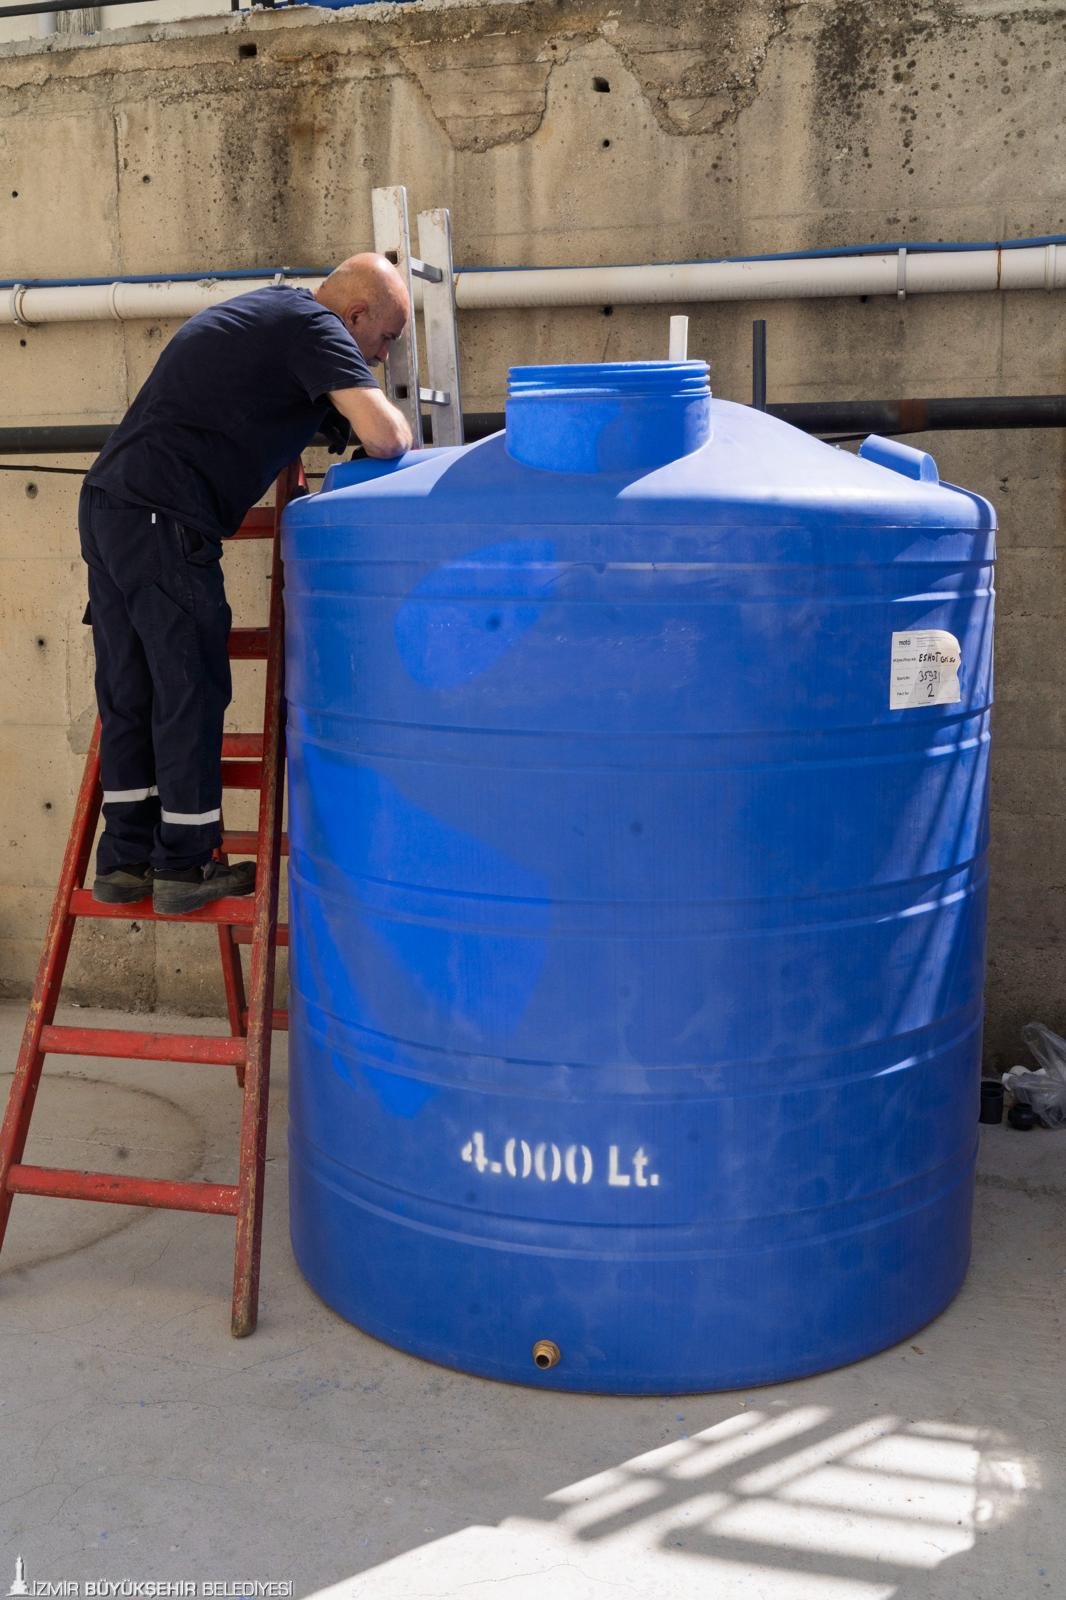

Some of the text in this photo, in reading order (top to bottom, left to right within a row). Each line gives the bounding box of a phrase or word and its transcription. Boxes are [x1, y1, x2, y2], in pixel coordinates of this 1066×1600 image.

[927, 683, 934, 697] 2
[460, 1131, 660, 1187] 4.000 Lt.
